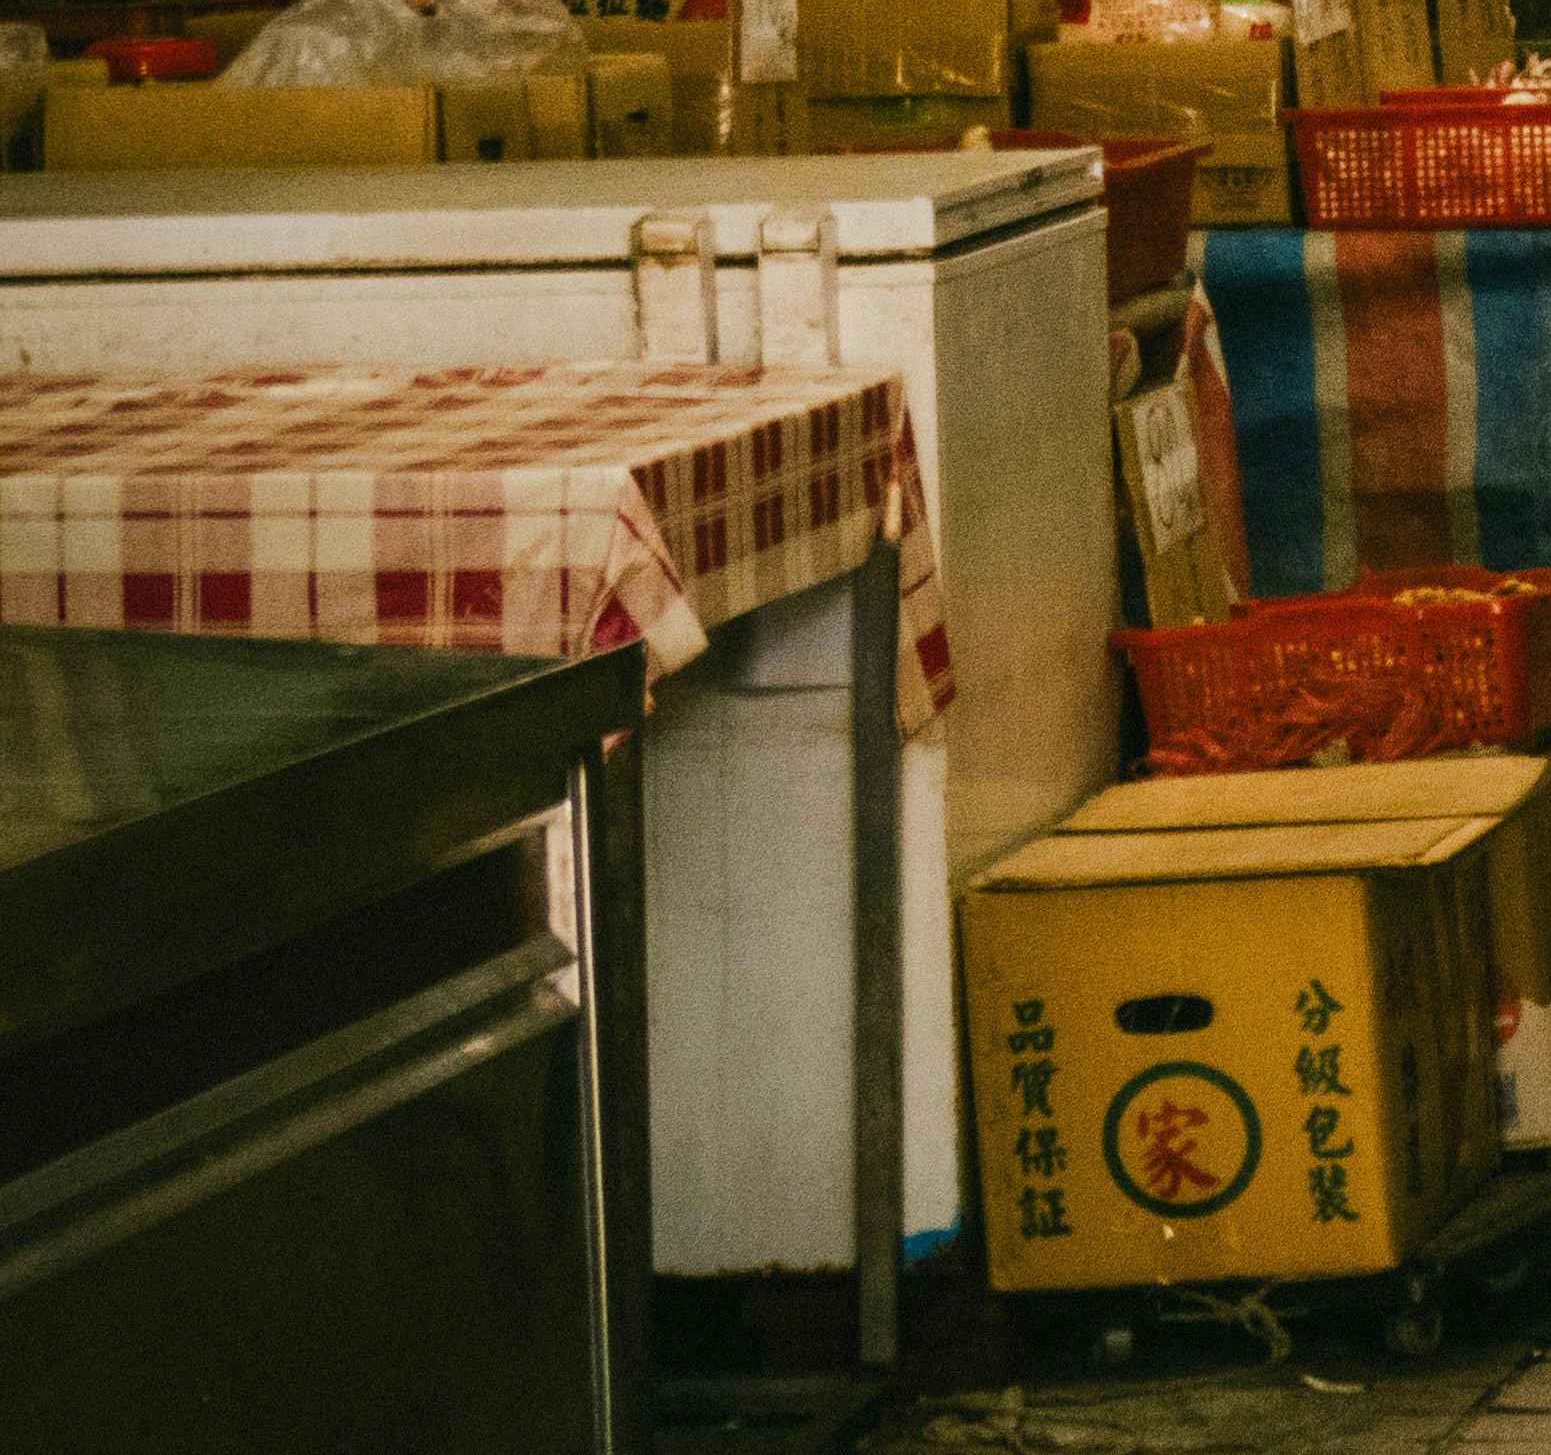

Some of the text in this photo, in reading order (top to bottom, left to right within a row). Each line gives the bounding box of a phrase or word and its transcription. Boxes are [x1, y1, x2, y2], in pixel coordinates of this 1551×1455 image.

[1135, 1099, 1223, 1201] 家
[1293, 977, 1359, 1225] 分級包裝
